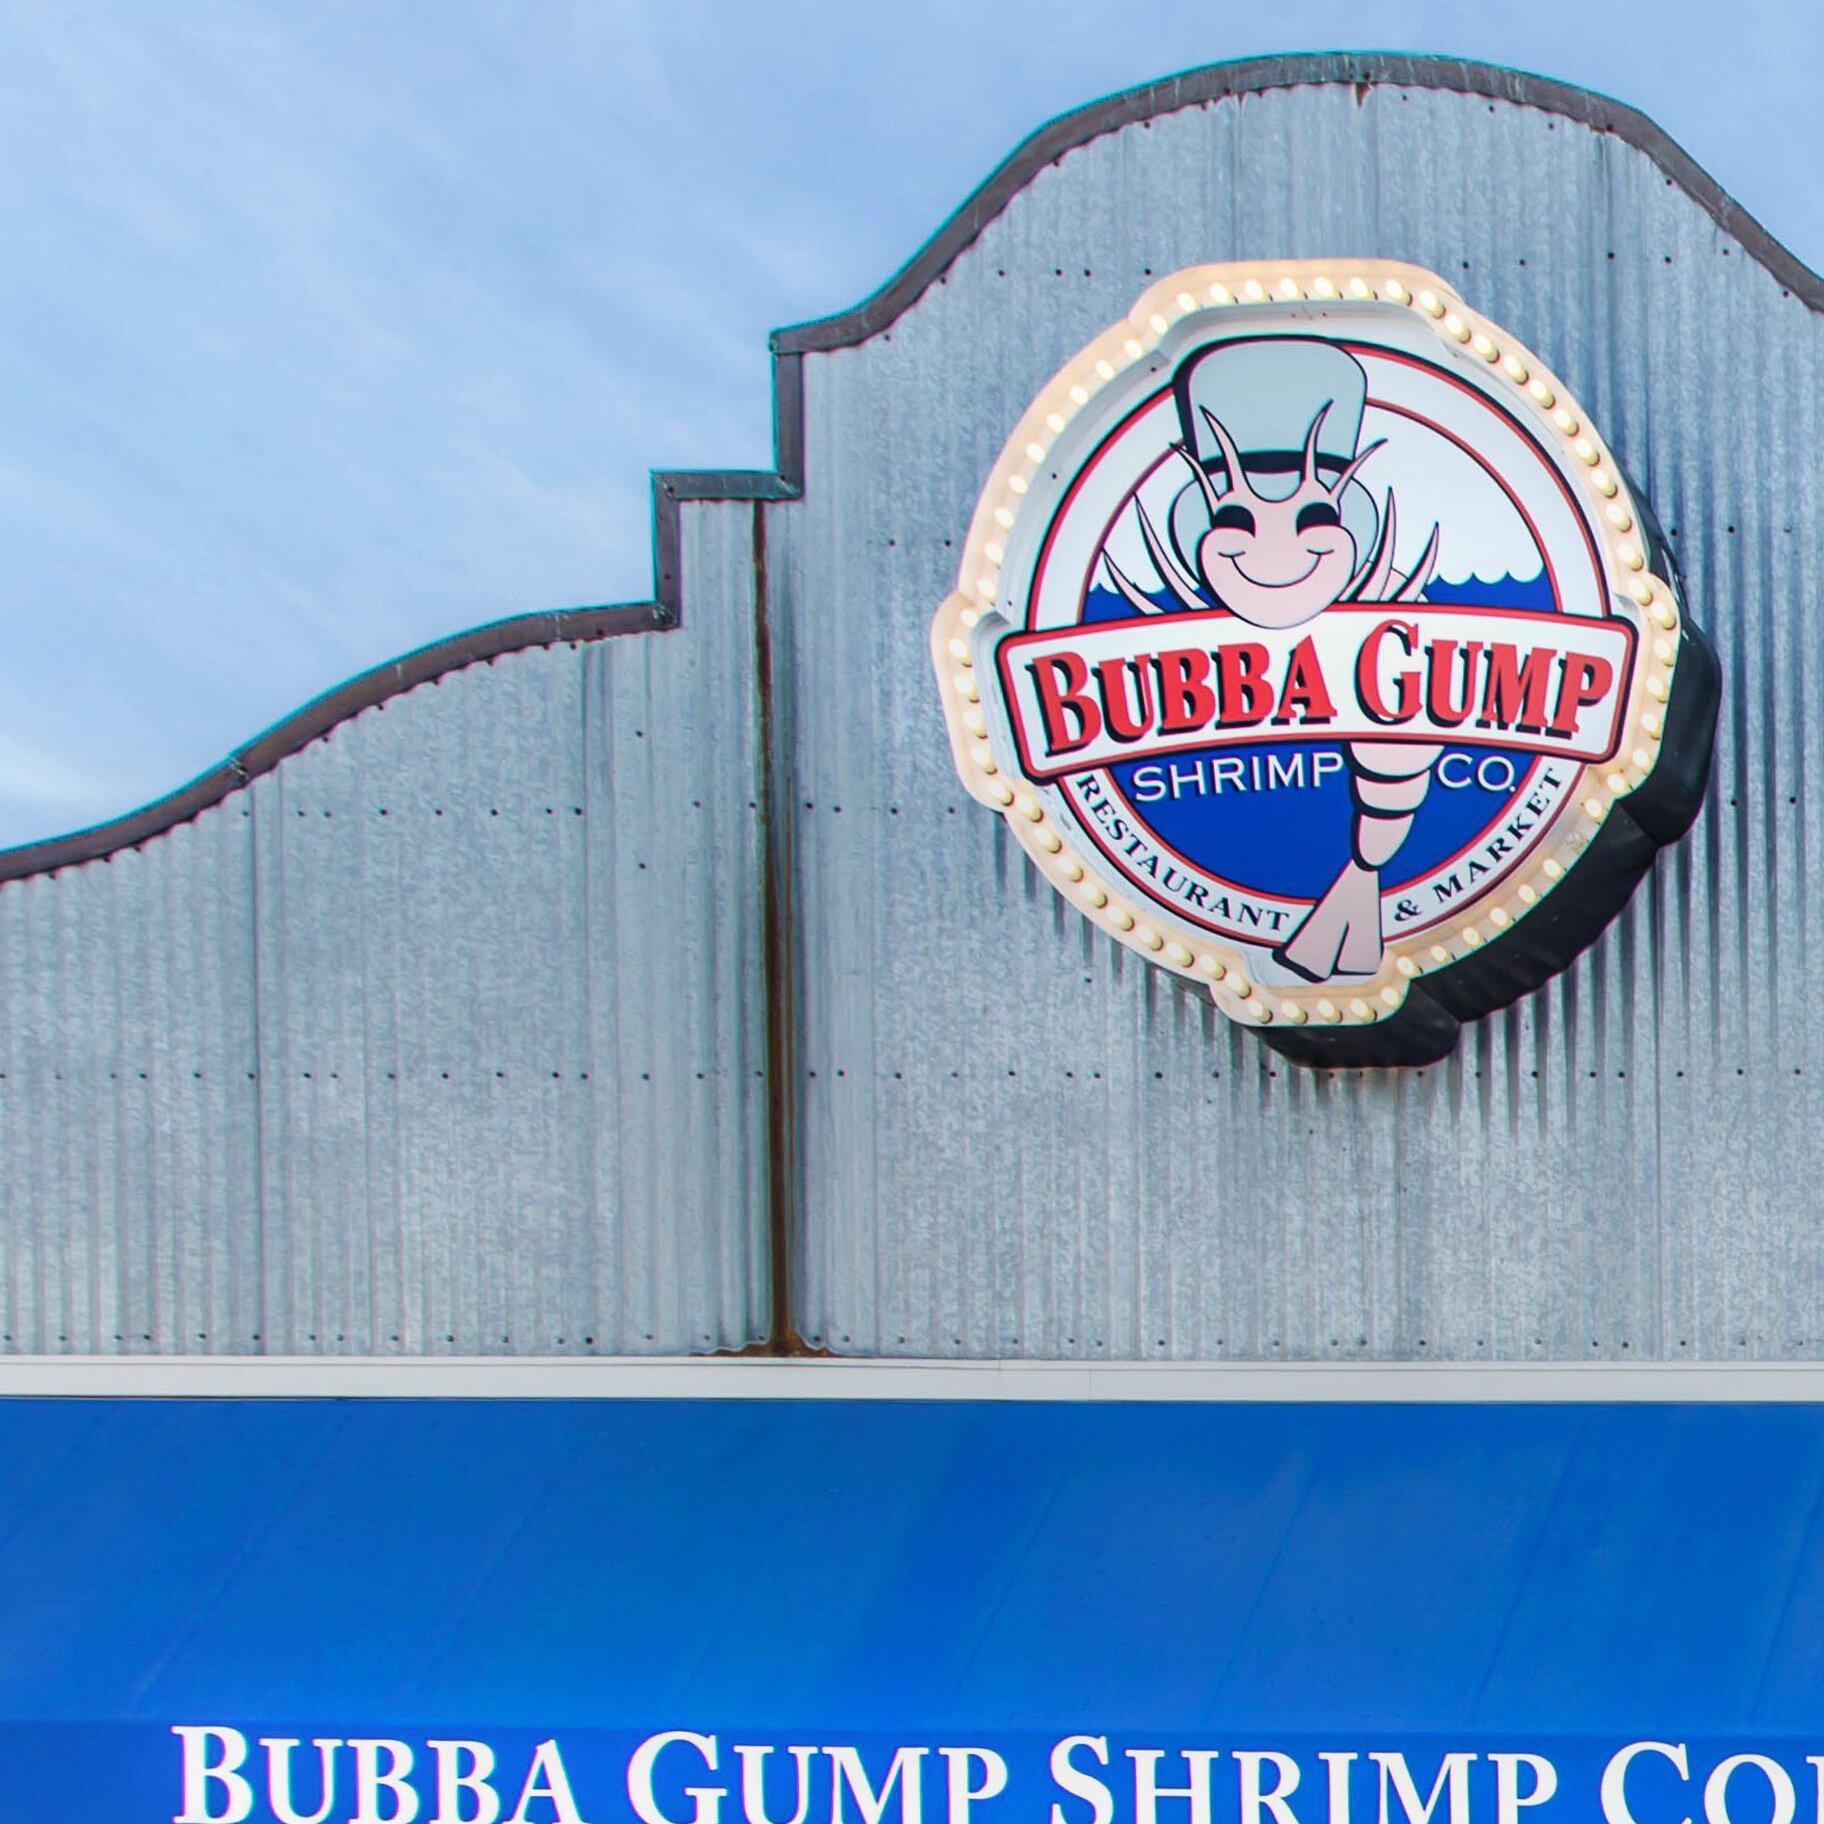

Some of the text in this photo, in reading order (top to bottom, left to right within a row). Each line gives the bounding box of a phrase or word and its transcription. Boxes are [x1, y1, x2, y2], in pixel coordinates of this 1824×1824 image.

[1026, 618, 1614, 758] BUBBA GUMP
[1133, 751, 1516, 803] SHRIMP CO.
[1076, 766, 1565, 932] RESTAURANT & MARKET
